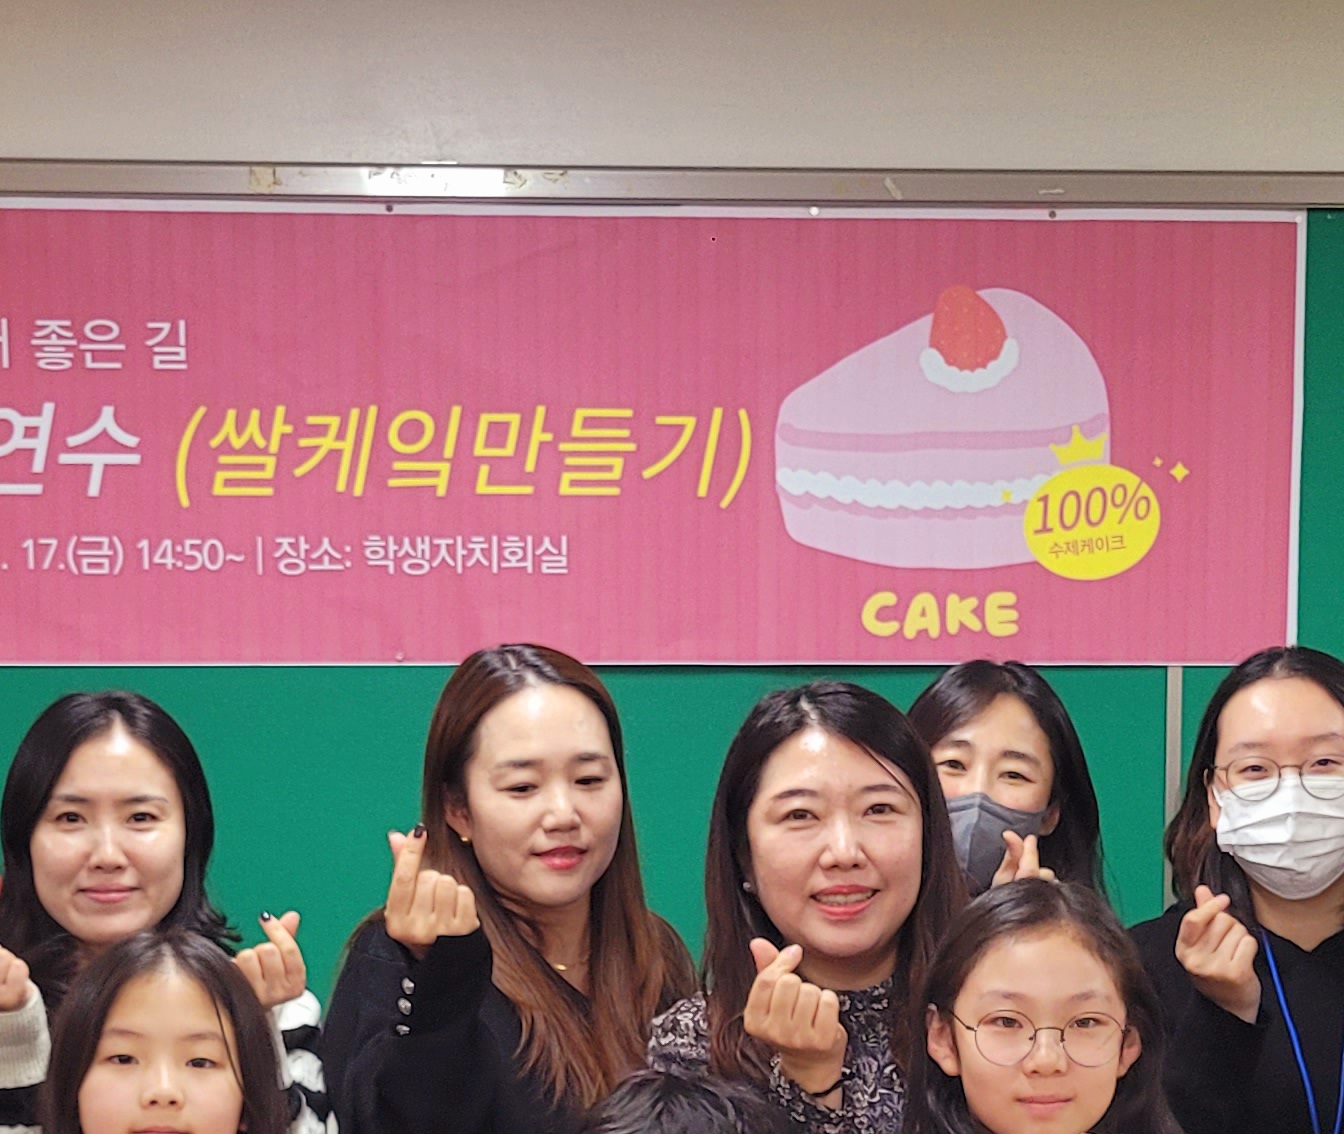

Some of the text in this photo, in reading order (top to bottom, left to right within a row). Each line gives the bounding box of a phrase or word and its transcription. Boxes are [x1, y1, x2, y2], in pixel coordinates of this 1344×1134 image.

[30, 319, 126, 370] 좋은
[145, 319, 188, 370] 길
[175, 405, 752, 508] (쌀케잌만들기)
[1033, 480, 1151, 535] 100%
[22, 535, 124, 575] 17.(금)
[137, 538, 245, 571] 14:50~
[274, 535, 352, 575] 장소:
[363, 535, 569, 576] 학생자치회실
[1048, 534, 1127, 559] 수제케이크
[861, 590, 1019, 640] CAKE
